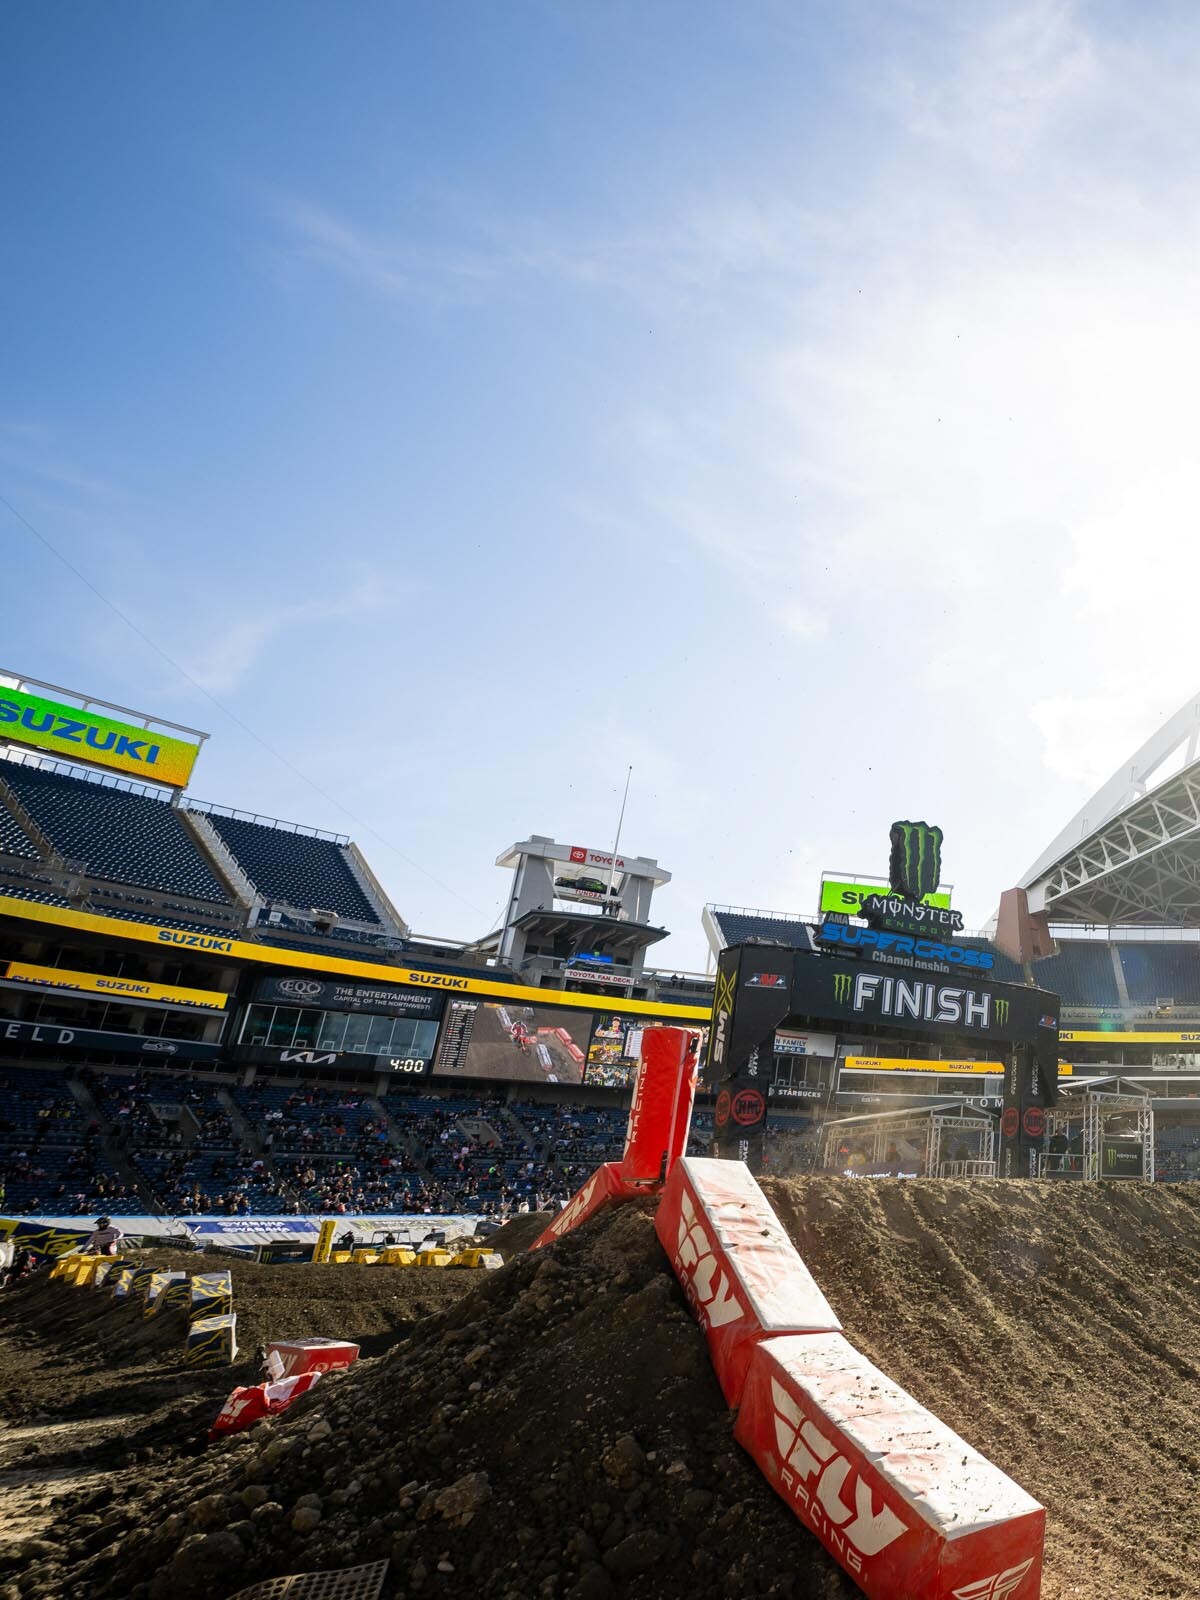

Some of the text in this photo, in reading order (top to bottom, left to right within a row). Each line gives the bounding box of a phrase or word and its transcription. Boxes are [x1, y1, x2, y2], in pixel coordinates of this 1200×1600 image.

[0, 701, 161, 765] SUZUKI
[590, 854, 625, 868] TOYOTA
[828, 913, 849, 925] AMA
[872, 897, 963, 929] MONSTER
[885, 919, 949, 936] ENERGY
[158, 930, 232, 952] SUZUKI
[820, 923, 995, 969] SUPERCROSS
[872, 951, 950, 974] Championship
[409, 973, 469, 989] SUZUKI
[569, 971, 595, 980] TOYOTA
[96, 980, 150, 994] SUZUKI
[335, 987, 432, 1004] THE ENTERTAINMENT
[333, 995, 361, 1003] CAPITAL
[853, 973, 991, 1028] FINISH
[280, 1050, 336, 1064] KIA
[390, 1059, 424, 1072] 4:00
[778, 1087, 821, 1098] STARBUCKS
[678, 1188, 744, 1327] FLY
[771, 1376, 908, 1556] FLY
[781, 1468, 863, 1574] RACING
